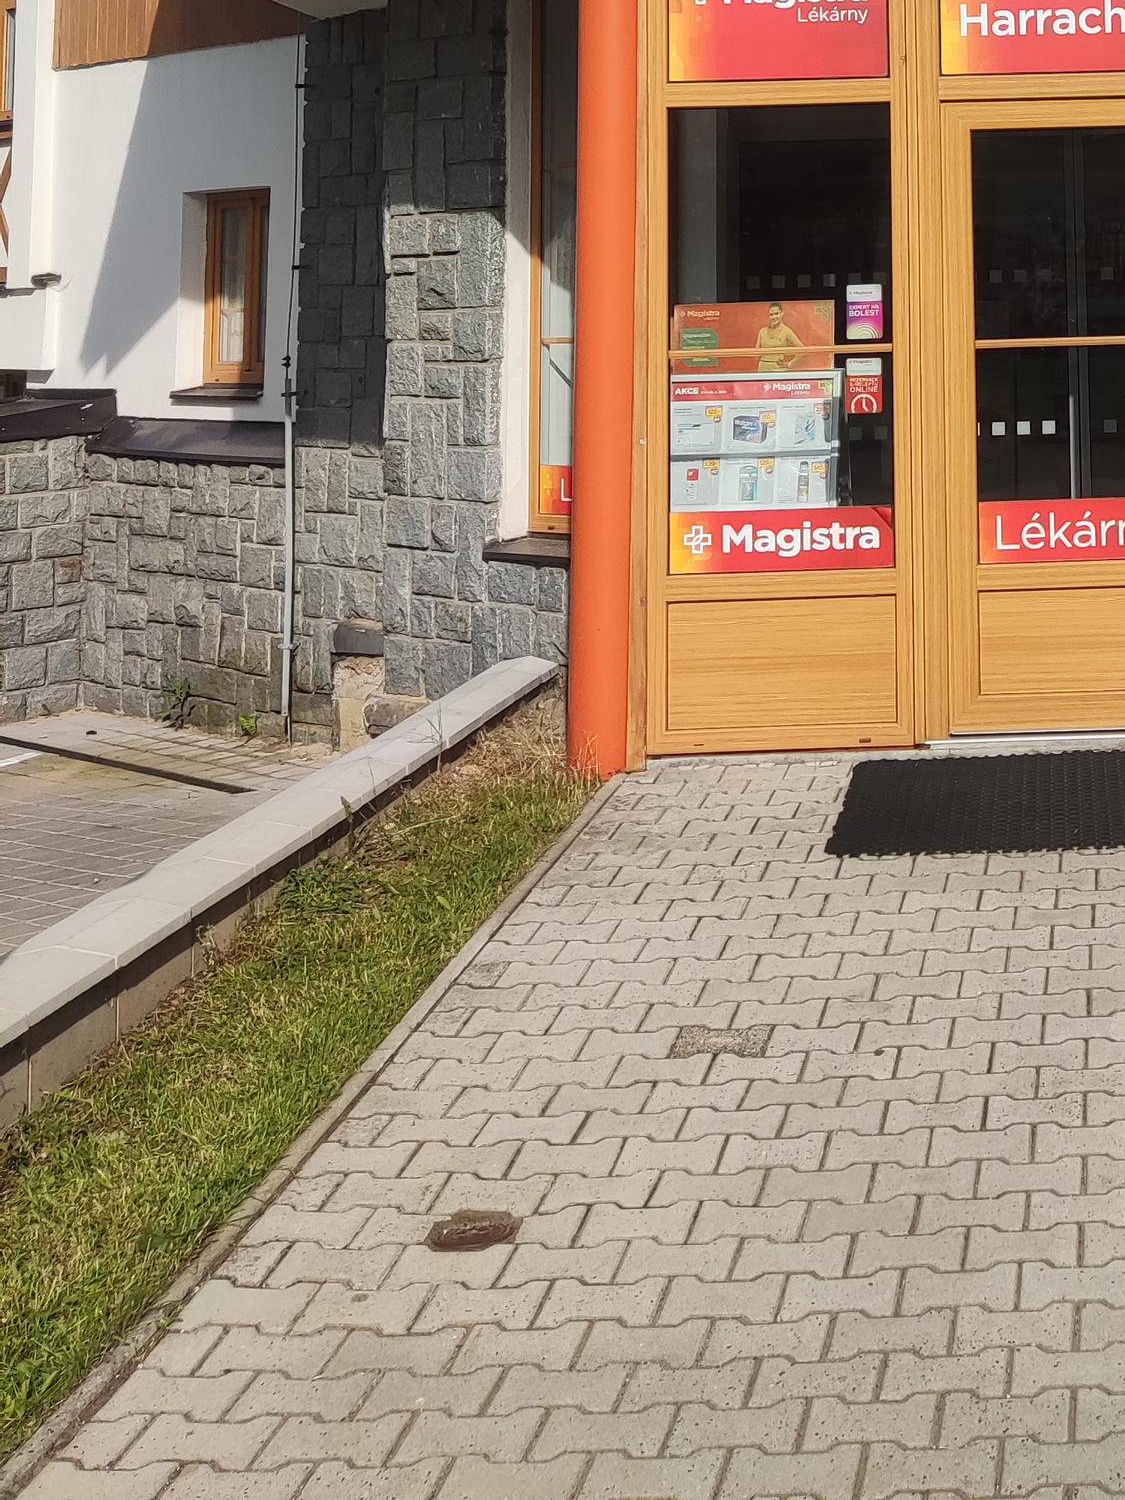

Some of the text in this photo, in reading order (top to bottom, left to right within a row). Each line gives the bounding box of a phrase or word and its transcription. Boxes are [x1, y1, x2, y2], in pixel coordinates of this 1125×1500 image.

[796, 5, 869, 25] Lékárny
[848, 309, 880, 317] BOLEST
[772, 382, 811, 392] Magistra
[722, 521, 881, 558] Magistra
